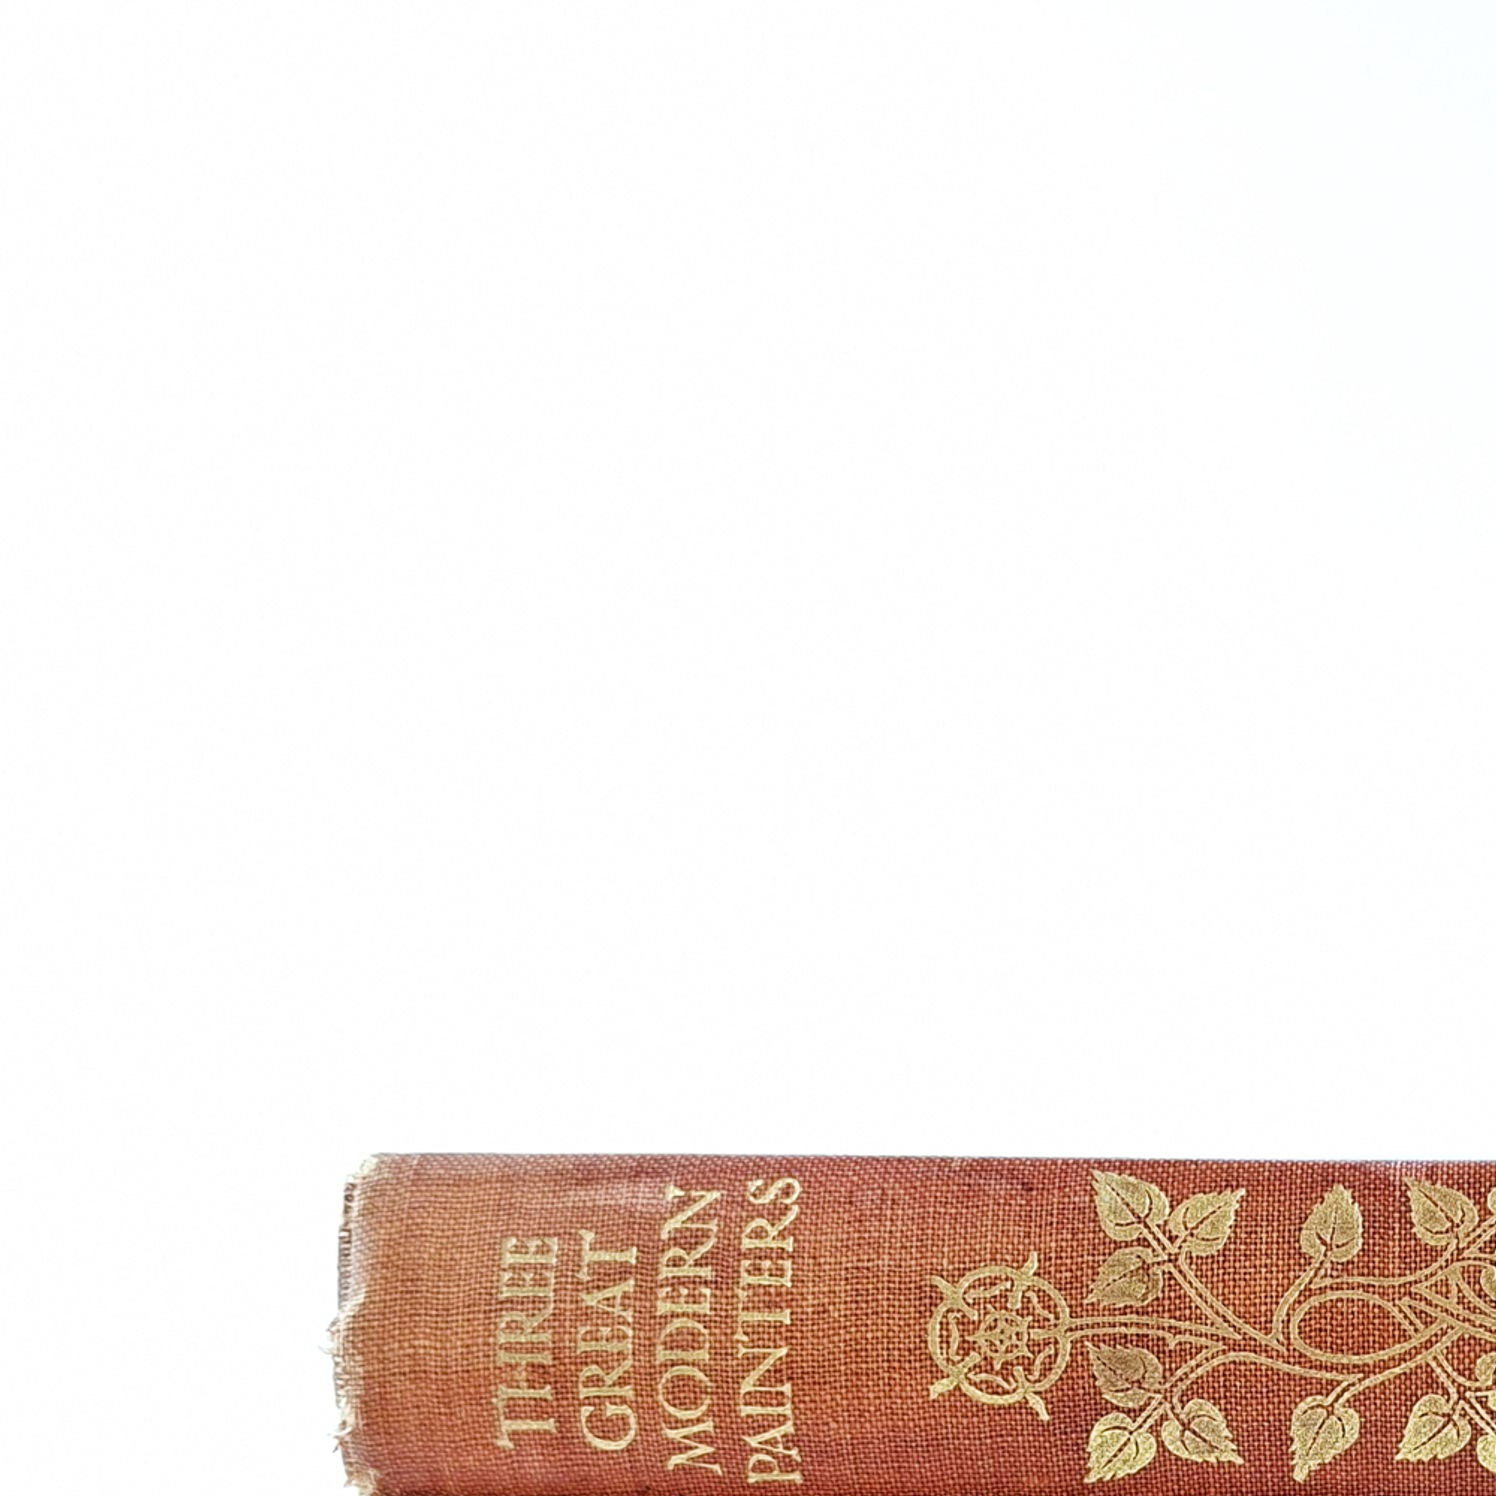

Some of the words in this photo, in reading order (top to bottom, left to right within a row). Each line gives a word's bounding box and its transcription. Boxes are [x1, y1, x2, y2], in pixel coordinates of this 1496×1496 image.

[492, 1236, 558, 1451] THREE
[576, 1229, 638, 1451] GREAT
[658, 1184, 723, 1476] MODERN
[734, 1176, 803, 1485] PAINTERS
